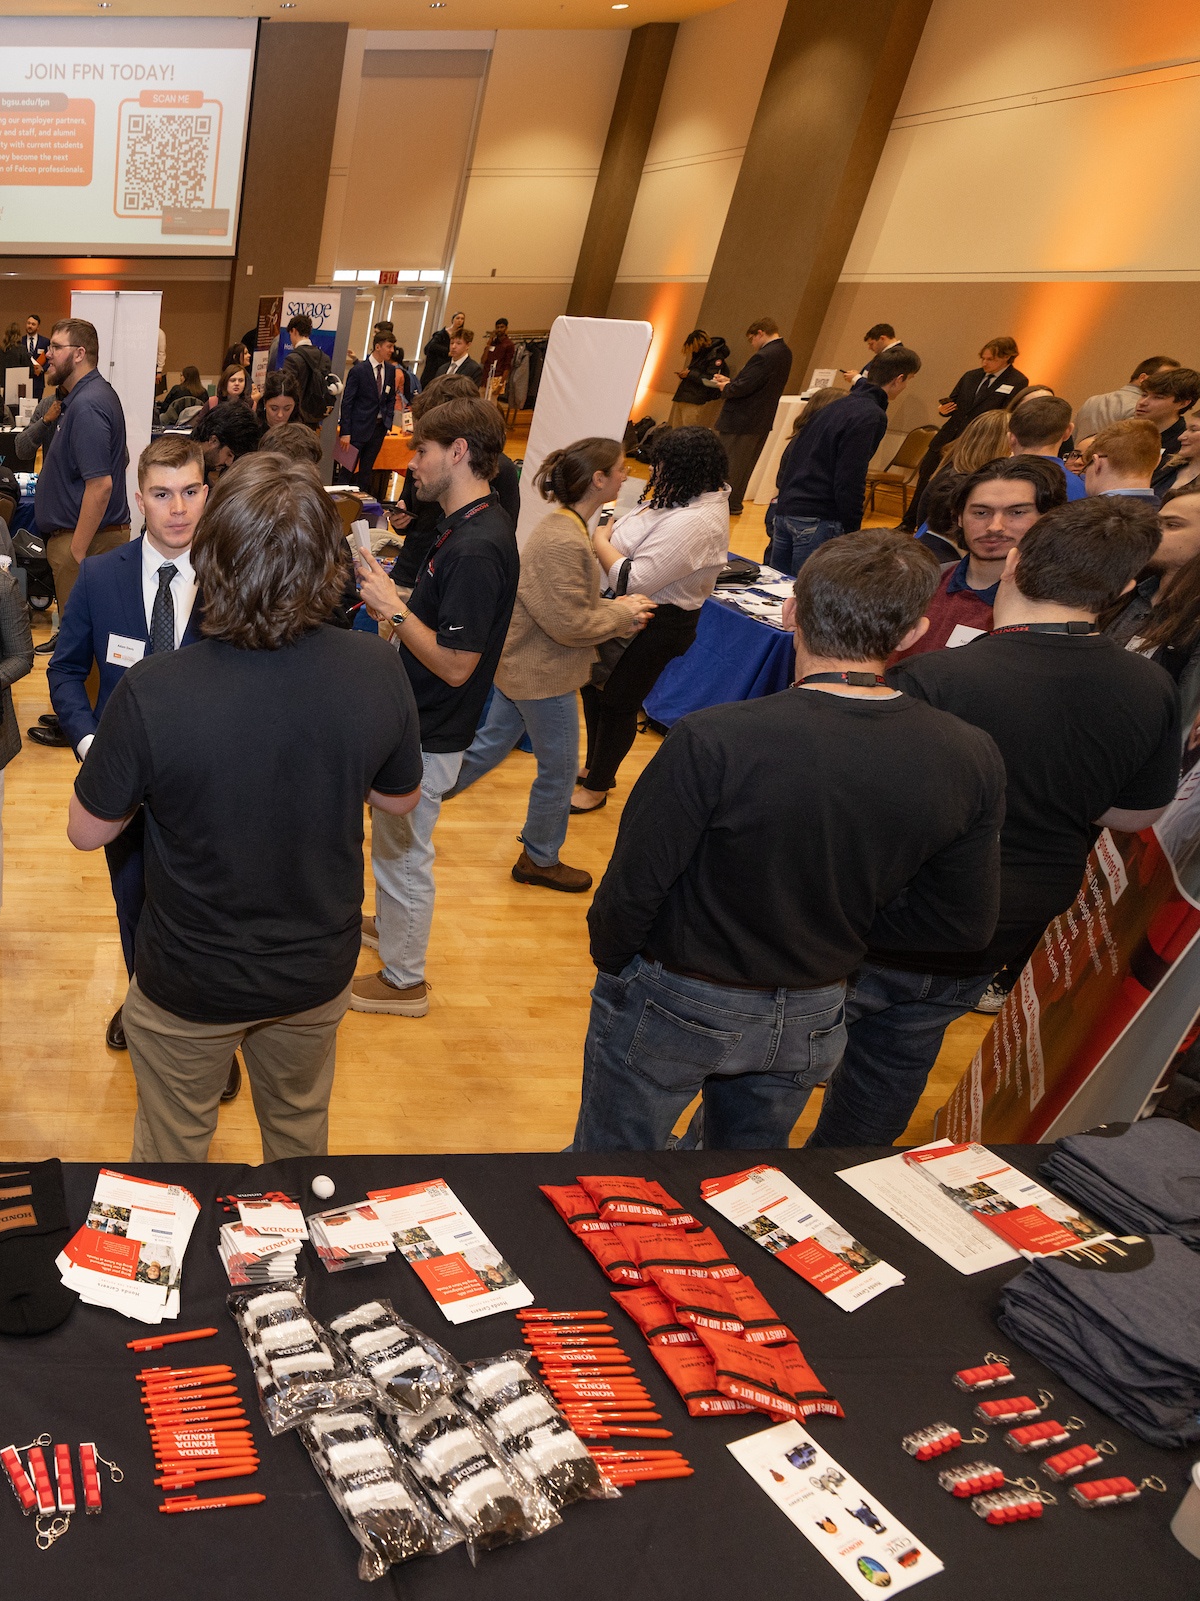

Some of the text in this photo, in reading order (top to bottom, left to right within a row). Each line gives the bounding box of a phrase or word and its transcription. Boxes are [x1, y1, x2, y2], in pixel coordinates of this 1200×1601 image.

[25, 64, 175, 81] JOIN FPN TODAY!
[1, 98, 50, 108] bgsu.edu/fpn
[153, 94, 190, 104] SCAN ME
[21, 116, 54, 126] employer
[55, 116, 87, 126] partners,
[3, 128, 16, 136] and
[18, 127, 37, 137] staff,
[38, 128, 51, 137] and
[53, 128, 76, 137] alumni
[10, 140, 25, 149] with
[26, 141, 52, 149] current
[53, 141, 83, 150] students
[11, 152, 38, 161] become
[40, 152, 51, 161] the
[52, 153, 69, 161] next
[6, 164, 13, 173] of
[14, 164, 37, 173] Falcon
[38, 165, 85, 175] professionals.
[286, 302, 332, 330] savage
[990, 626, 1030, 636] HONDA
[616, 1204, 663, 1216] FIRST AID KIT
[677, 1215, 694, 1225] FIRST
[261, 1226, 304, 1234] HONDA
[589, 1222, 599, 1231] KIT
[257, 1237, 297, 1253] HONDA
[348, 1240, 390, 1251] HONDA
[629, 1270, 637, 1280] KIT
[688, 1268, 708, 1279] FIRST
[720, 1267, 740, 1278] FIRST
[98, 1282, 140, 1296] Honda Careers
[696, 1316, 745, 1332] FIRST AID KIT
[668, 1331, 693, 1344] AID KIT
[753, 1329, 787, 1343] FIRST AID
[276, 1342, 314, 1356] HONDA
[710, 1400, 737, 1412] AID KIT
[740, 1387, 797, 1416] FIRST AID KIT
[816, 1403, 837, 1415] FIRST
[174, 1433, 215, 1441] HONDA
[175, 1440, 217, 1448] HONDA
[178, 1448, 219, 1456] HONDA
[455, 1459, 489, 1480] HONDA
[349, 1469, 392, 1487] HONDA
[838, 1540, 864, 1556] HONDA
[887, 1537, 912, 1556] CIVIC
